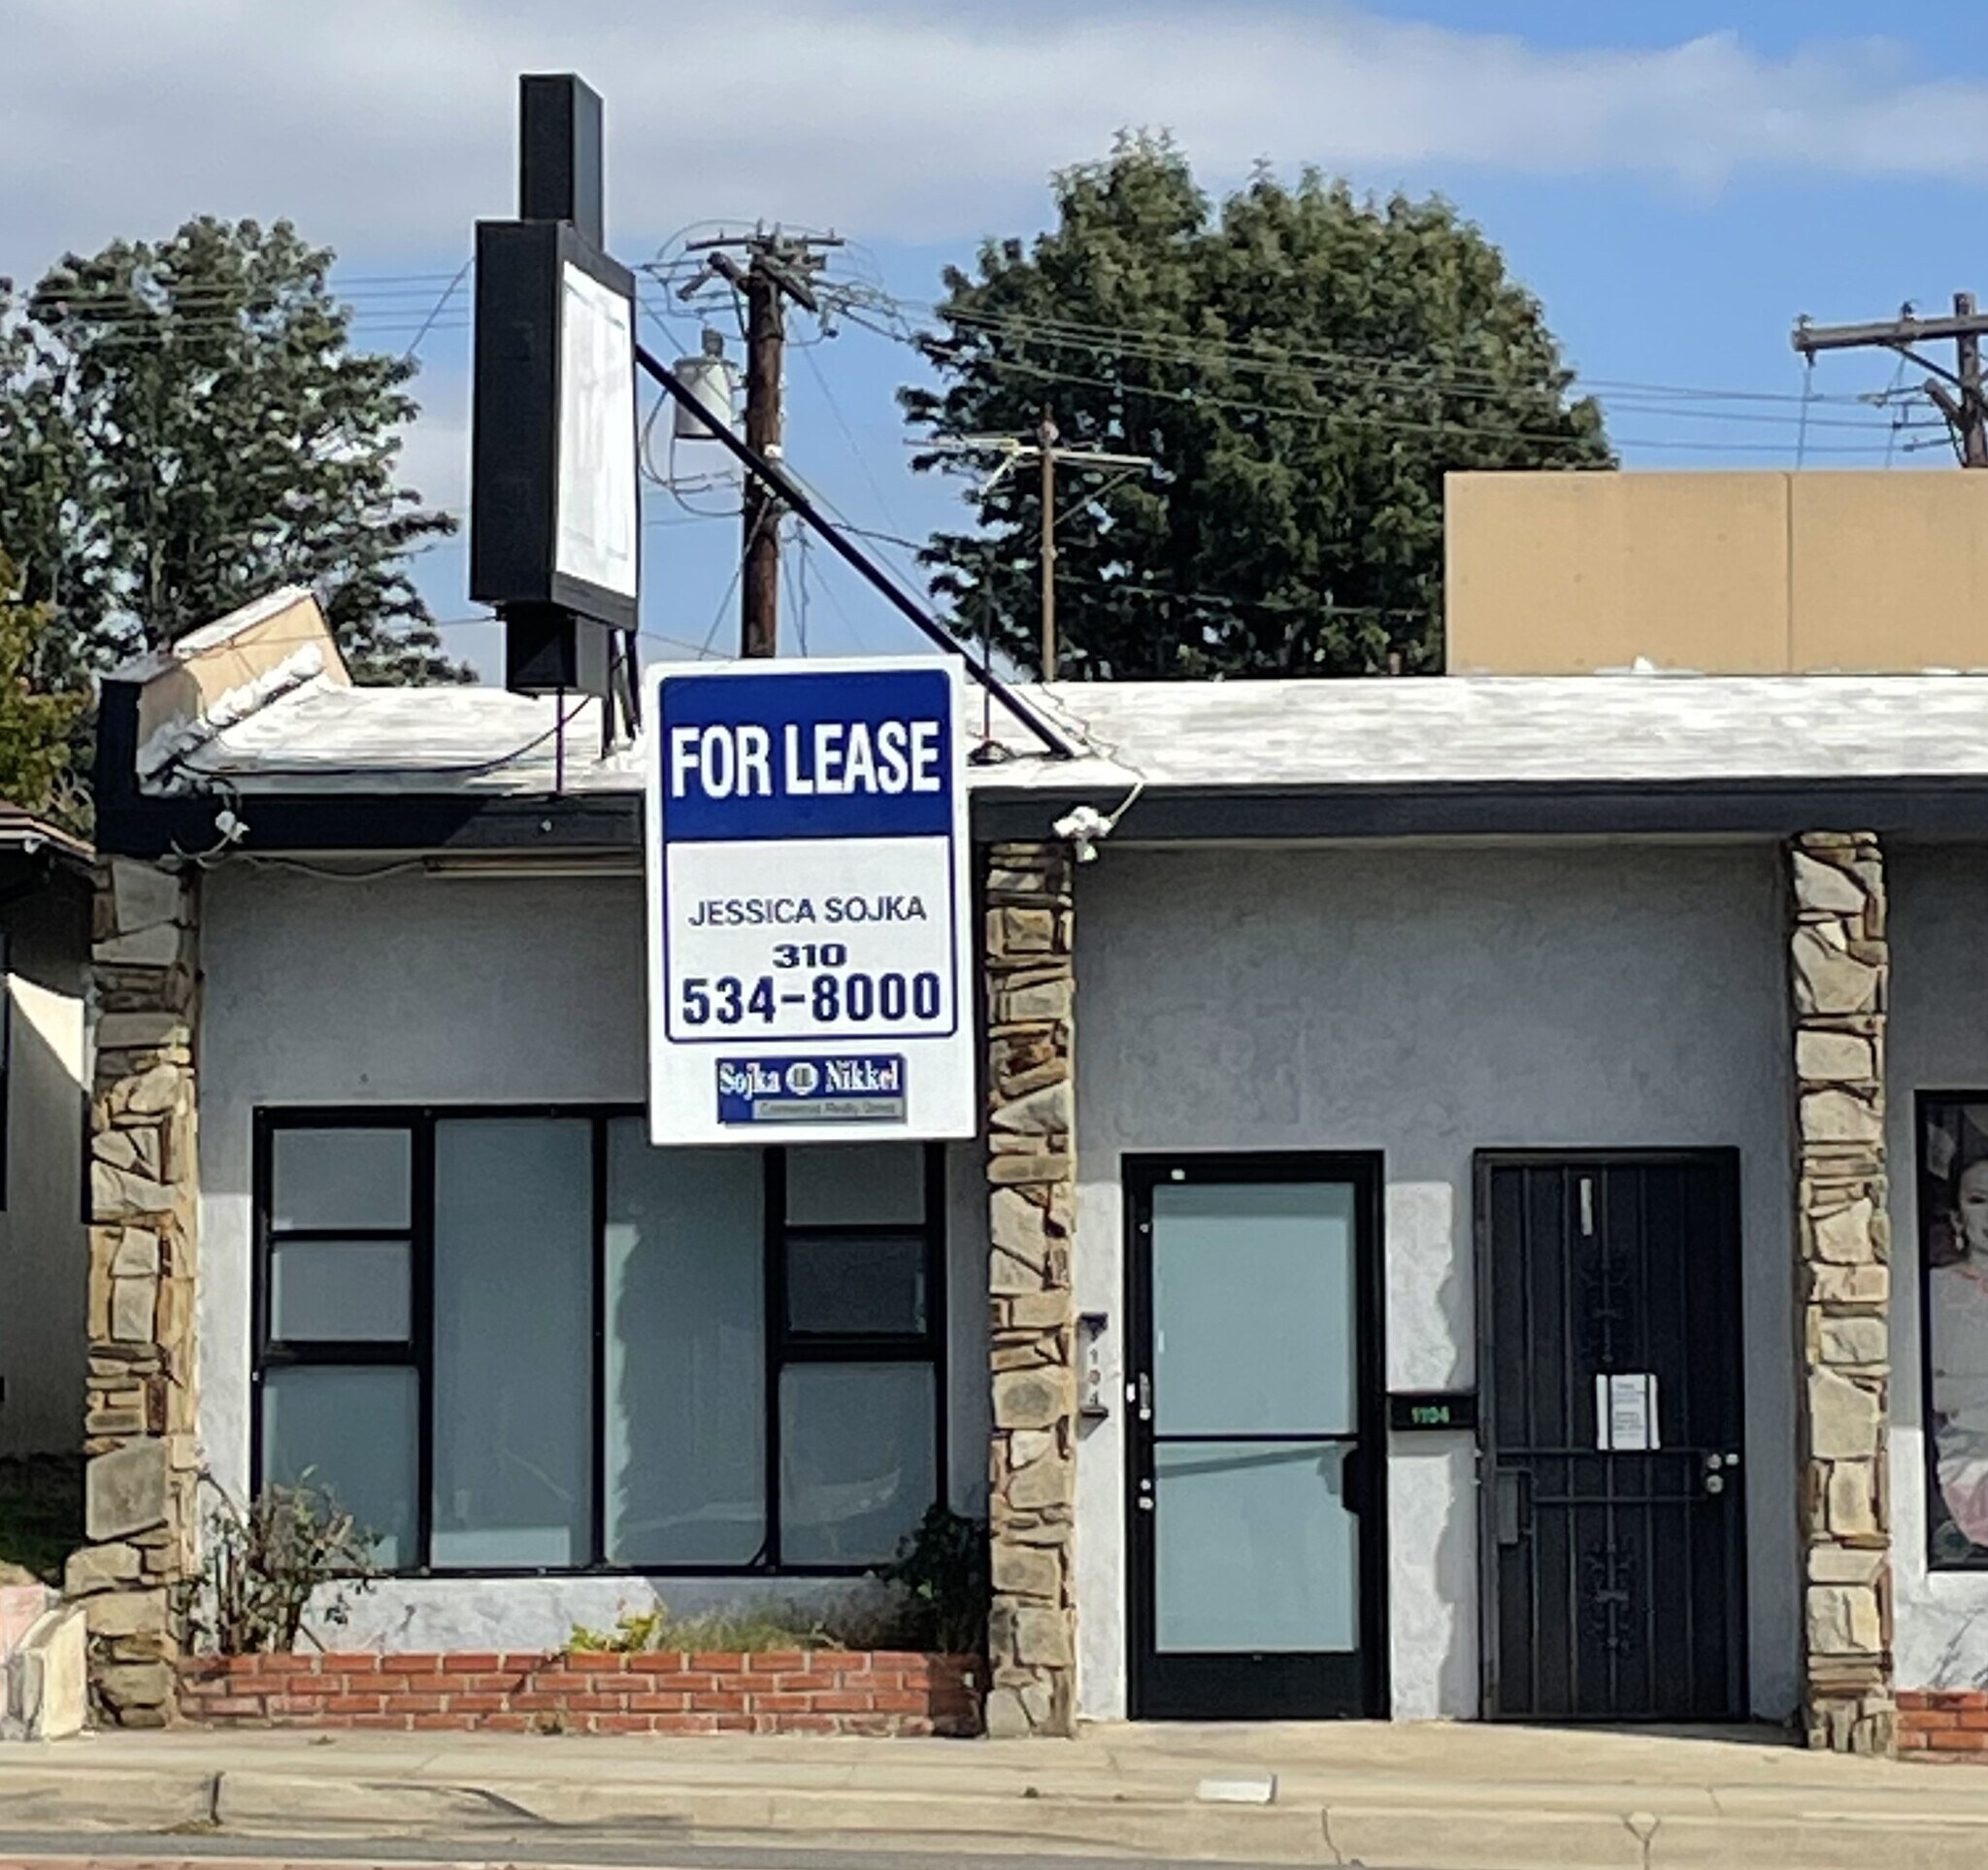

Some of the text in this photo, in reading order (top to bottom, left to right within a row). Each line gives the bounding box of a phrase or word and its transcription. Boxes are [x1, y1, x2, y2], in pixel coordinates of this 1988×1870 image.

[672, 720, 942, 798] FOR LEASE
[688, 895, 928, 926] JESSICA SOJKA
[773, 943, 848, 968] 310
[682, 971, 942, 1025] 534-8000
[719, 1059, 900, 1100] Sojka Nikkel
